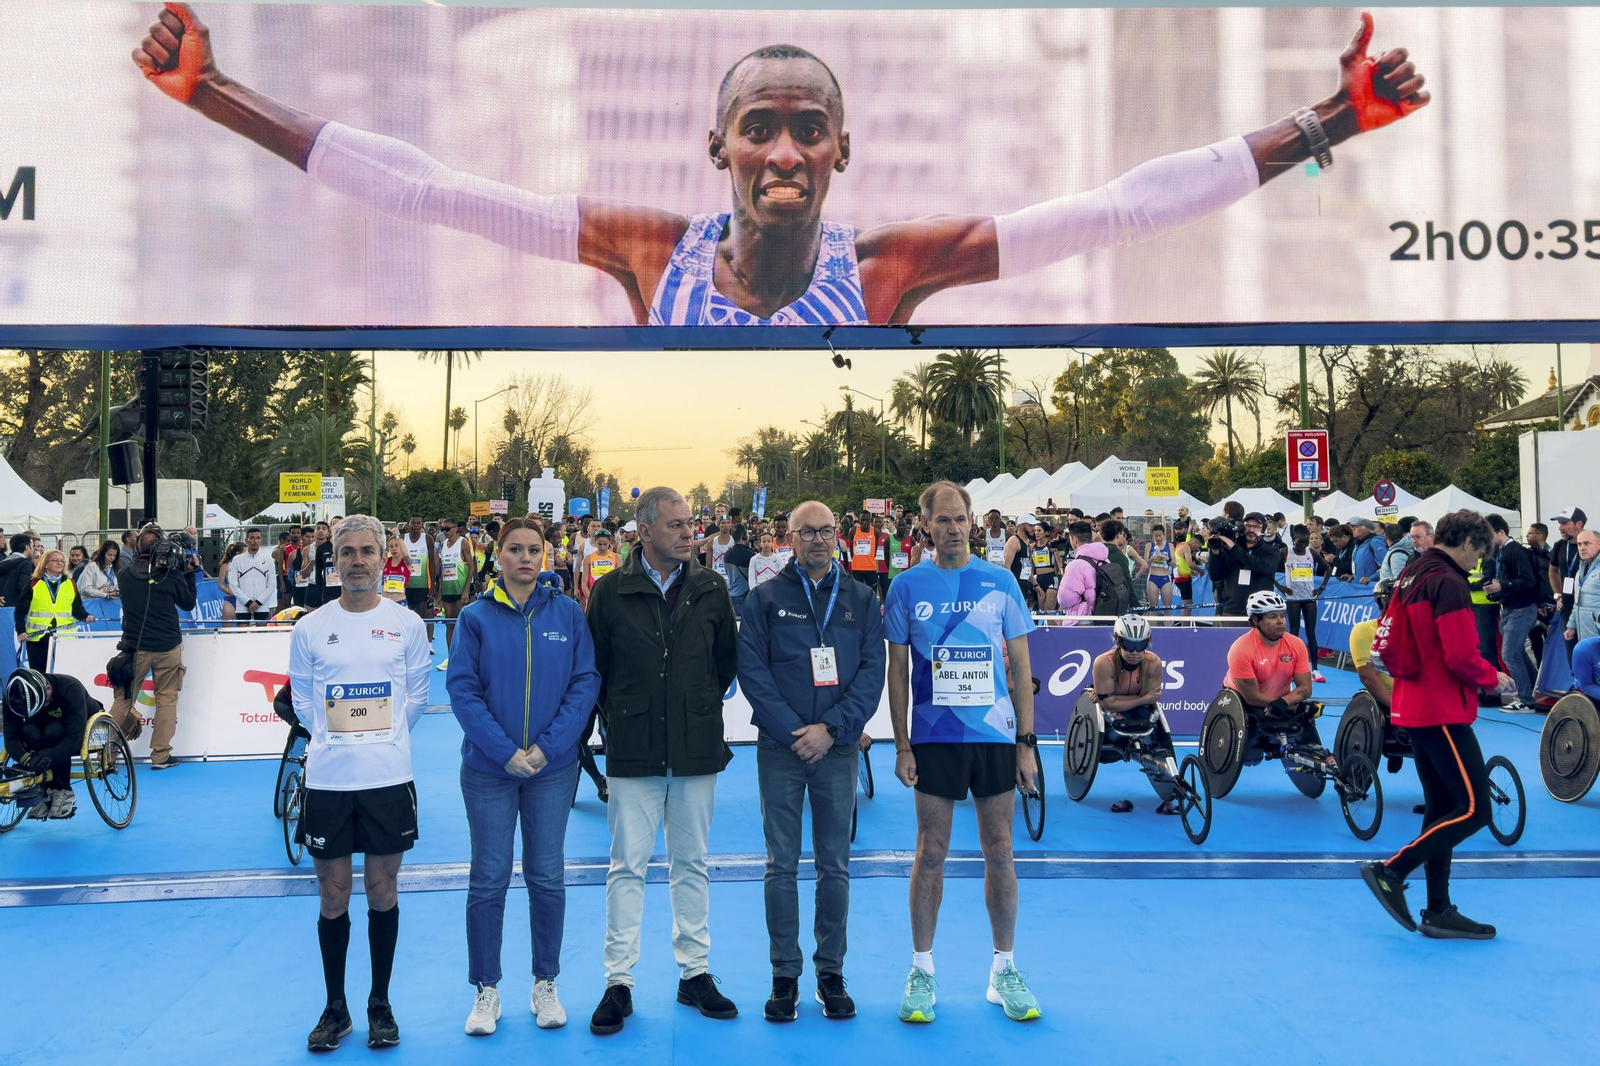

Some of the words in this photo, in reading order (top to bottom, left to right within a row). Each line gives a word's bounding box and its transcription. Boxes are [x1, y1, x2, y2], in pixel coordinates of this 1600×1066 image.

[1389, 219, 1600, 260] 2h00:35
[940, 601, 996, 614] ZURICH
[787, 611, 807, 619] ZURICH
[1320, 601, 1373, 626] ZURICH
[954, 651, 986, 659] ZURICH
[939, 671, 960, 680] ABEL
[962, 671, 989, 680] ANTON
[348, 686, 385, 696] ZURICH
[1184, 700, 1209, 713] body
[350, 707, 367, 717] 200
